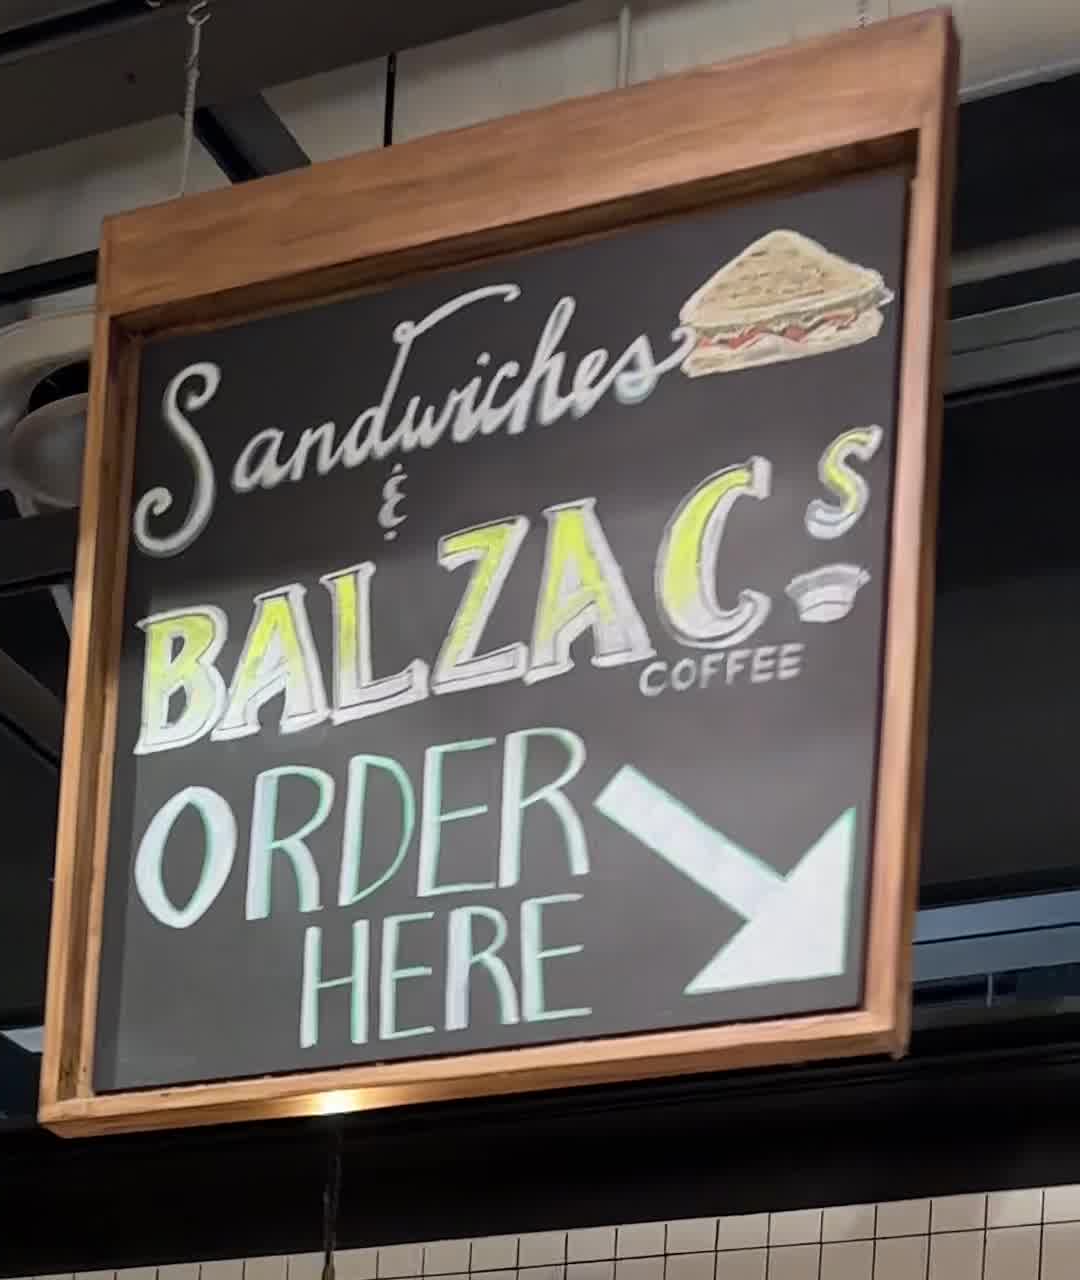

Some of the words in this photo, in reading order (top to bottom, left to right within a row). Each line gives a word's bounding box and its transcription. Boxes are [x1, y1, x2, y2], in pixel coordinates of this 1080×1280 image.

[134, 283, 696, 556] Sandwiches
[638, 643, 806, 697] COFFEE
[134, 727, 590, 928] ORDER
[299, 893, 592, 1049] HERE
